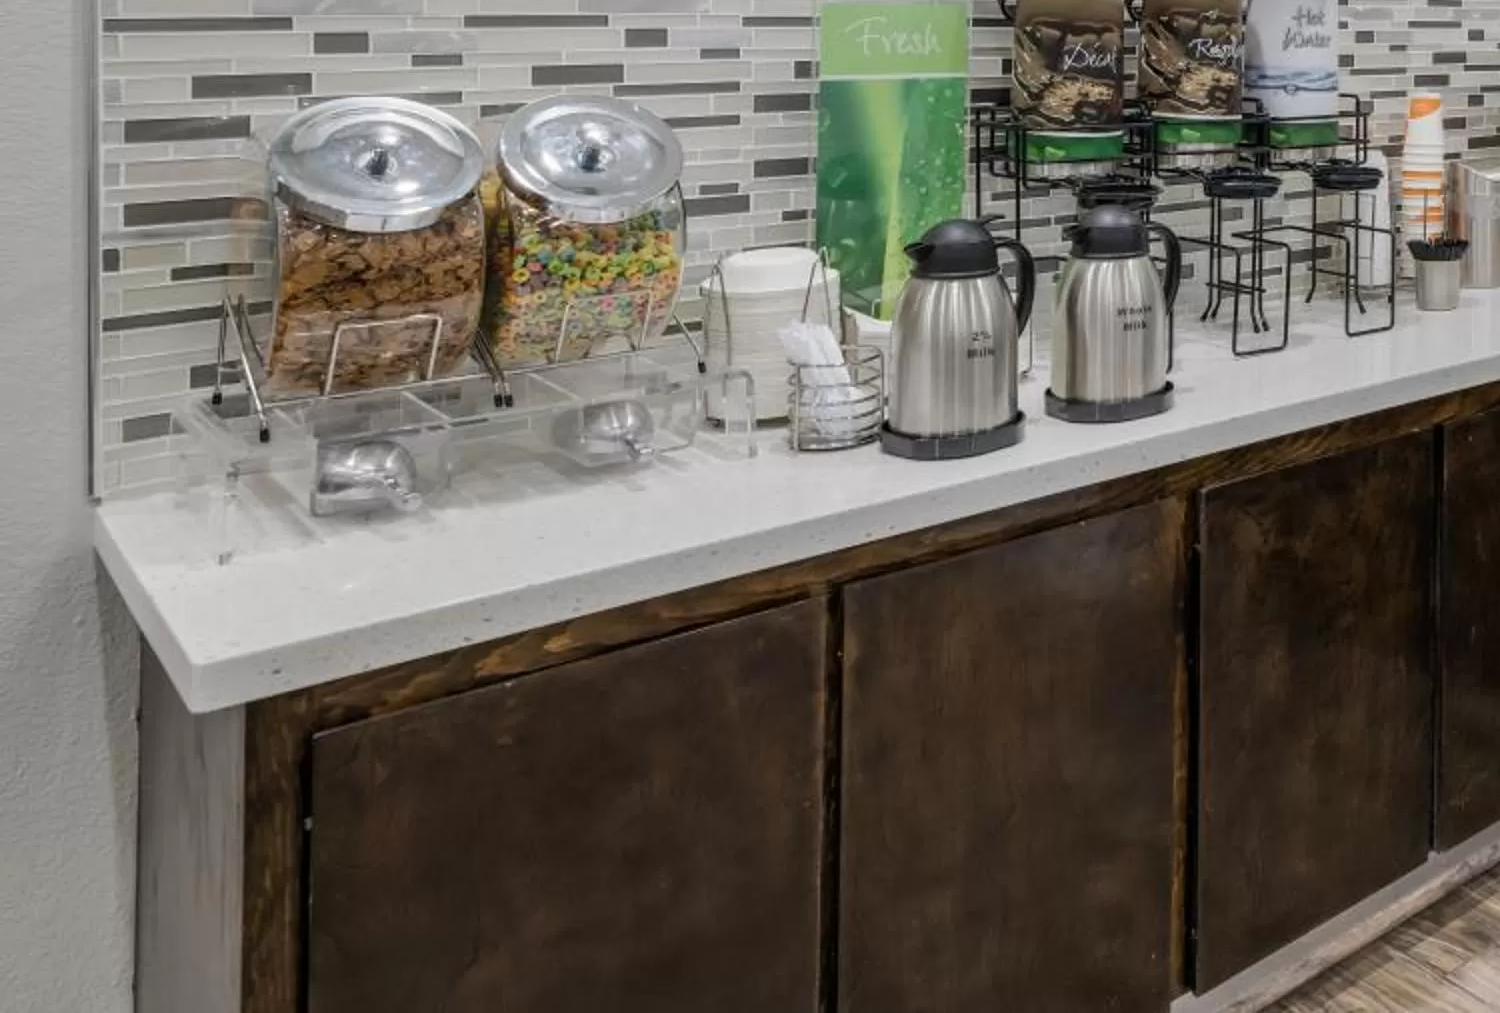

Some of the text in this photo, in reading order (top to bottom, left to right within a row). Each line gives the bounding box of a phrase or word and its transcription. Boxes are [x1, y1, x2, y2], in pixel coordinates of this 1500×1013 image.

[1291, 5, 1326, 27] Hot
[844, 15, 943, 58] Fresh
[1281, 27, 1333, 51] Water
[1123, 321, 1147, 332] Milk
[967, 347, 996, 359] Milk
